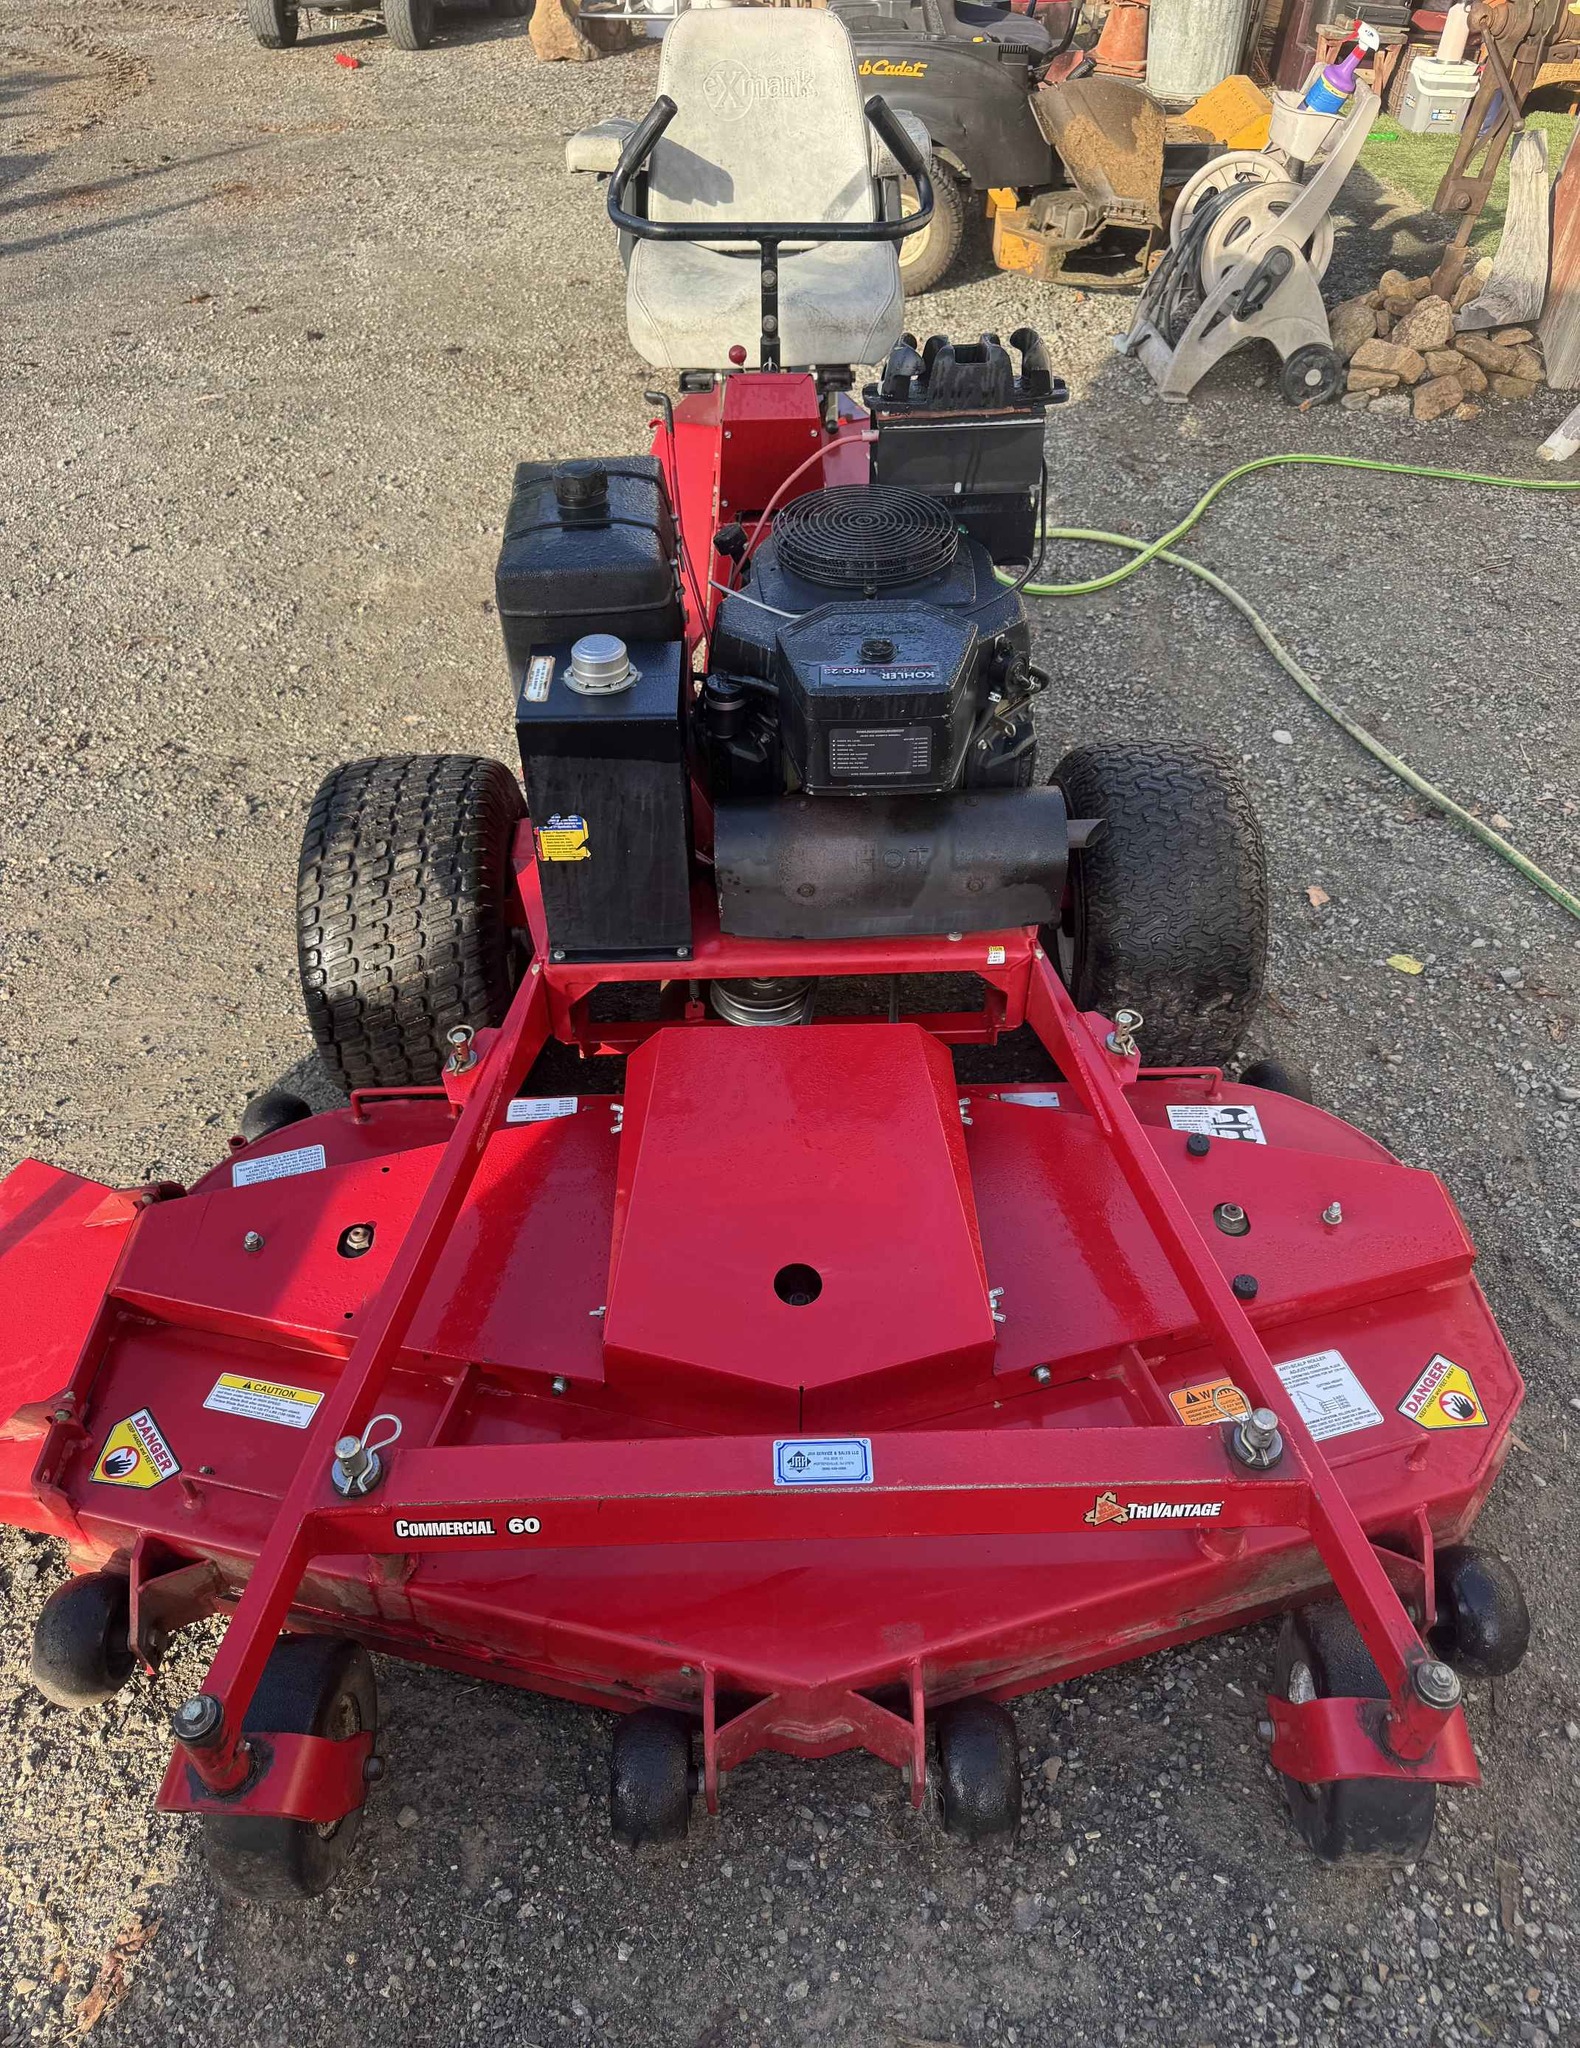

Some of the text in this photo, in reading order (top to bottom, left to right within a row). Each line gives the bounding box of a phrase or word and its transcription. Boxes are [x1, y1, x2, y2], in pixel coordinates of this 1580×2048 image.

[871, 59, 928, 78] Cadet
[882, 671, 935, 680] KOHLER
[254, 1383, 297, 1398] CAUTION
[1405, 1362, 1447, 1414] DANGER
[134, 1416, 172, 1472] DANGER
[396, 1518, 540, 1537] COMMERCIAL 60
